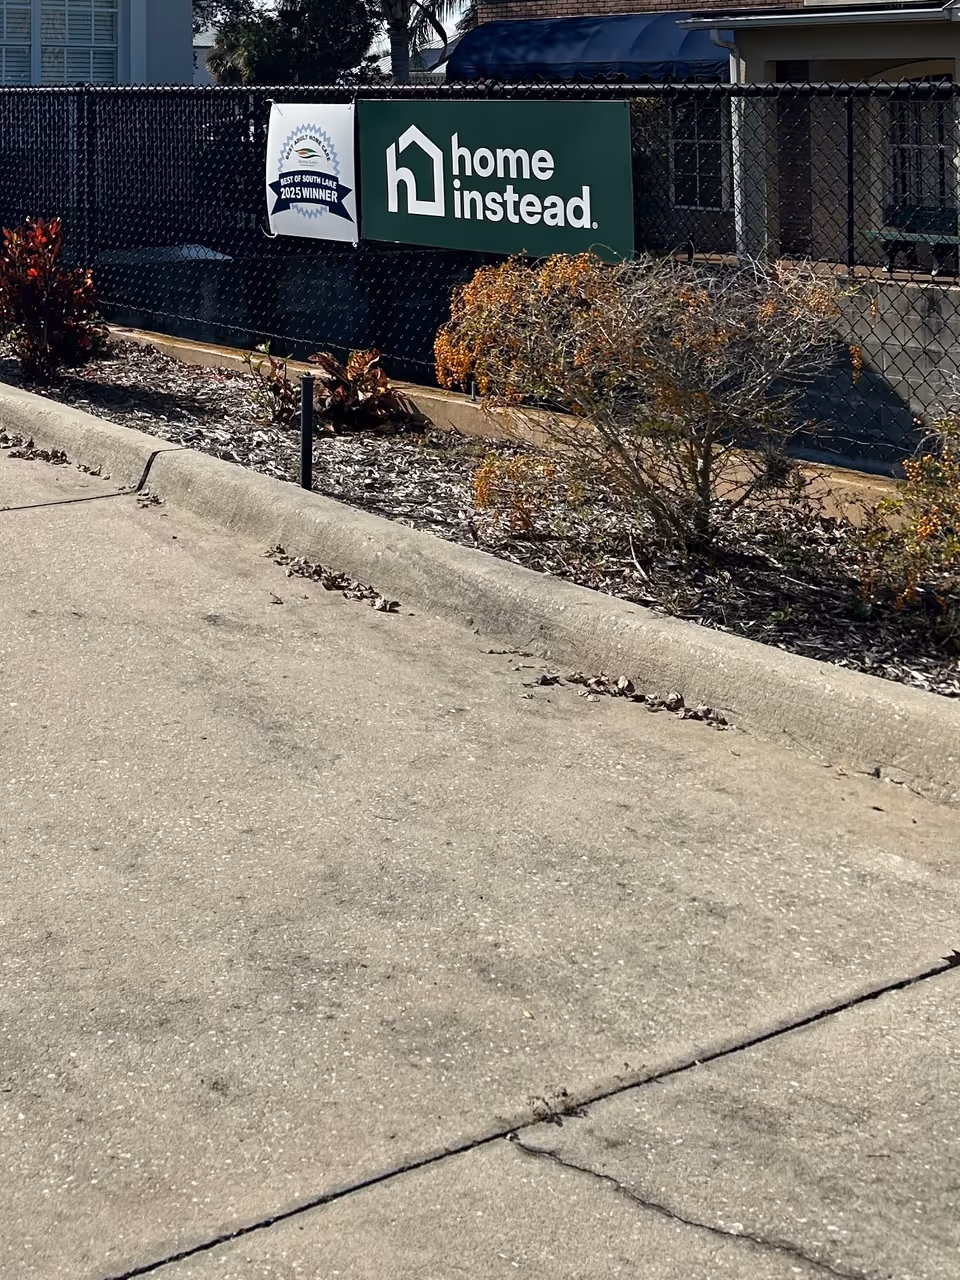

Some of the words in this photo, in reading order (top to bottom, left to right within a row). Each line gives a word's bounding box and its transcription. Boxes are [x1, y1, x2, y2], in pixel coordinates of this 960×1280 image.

[285, 144, 294, 160] BEST
[309, 135, 322, 147] HOME
[321, 144, 331, 161] CARE
[451, 131, 555, 181] home
[280, 176, 293, 185] BEST
[294, 175, 301, 183] OF
[302, 175, 321, 184] SOUTH
[322, 177, 337, 189] LAKE
[280, 187, 301, 199] 2025
[302, 187, 338, 203] WINNER
